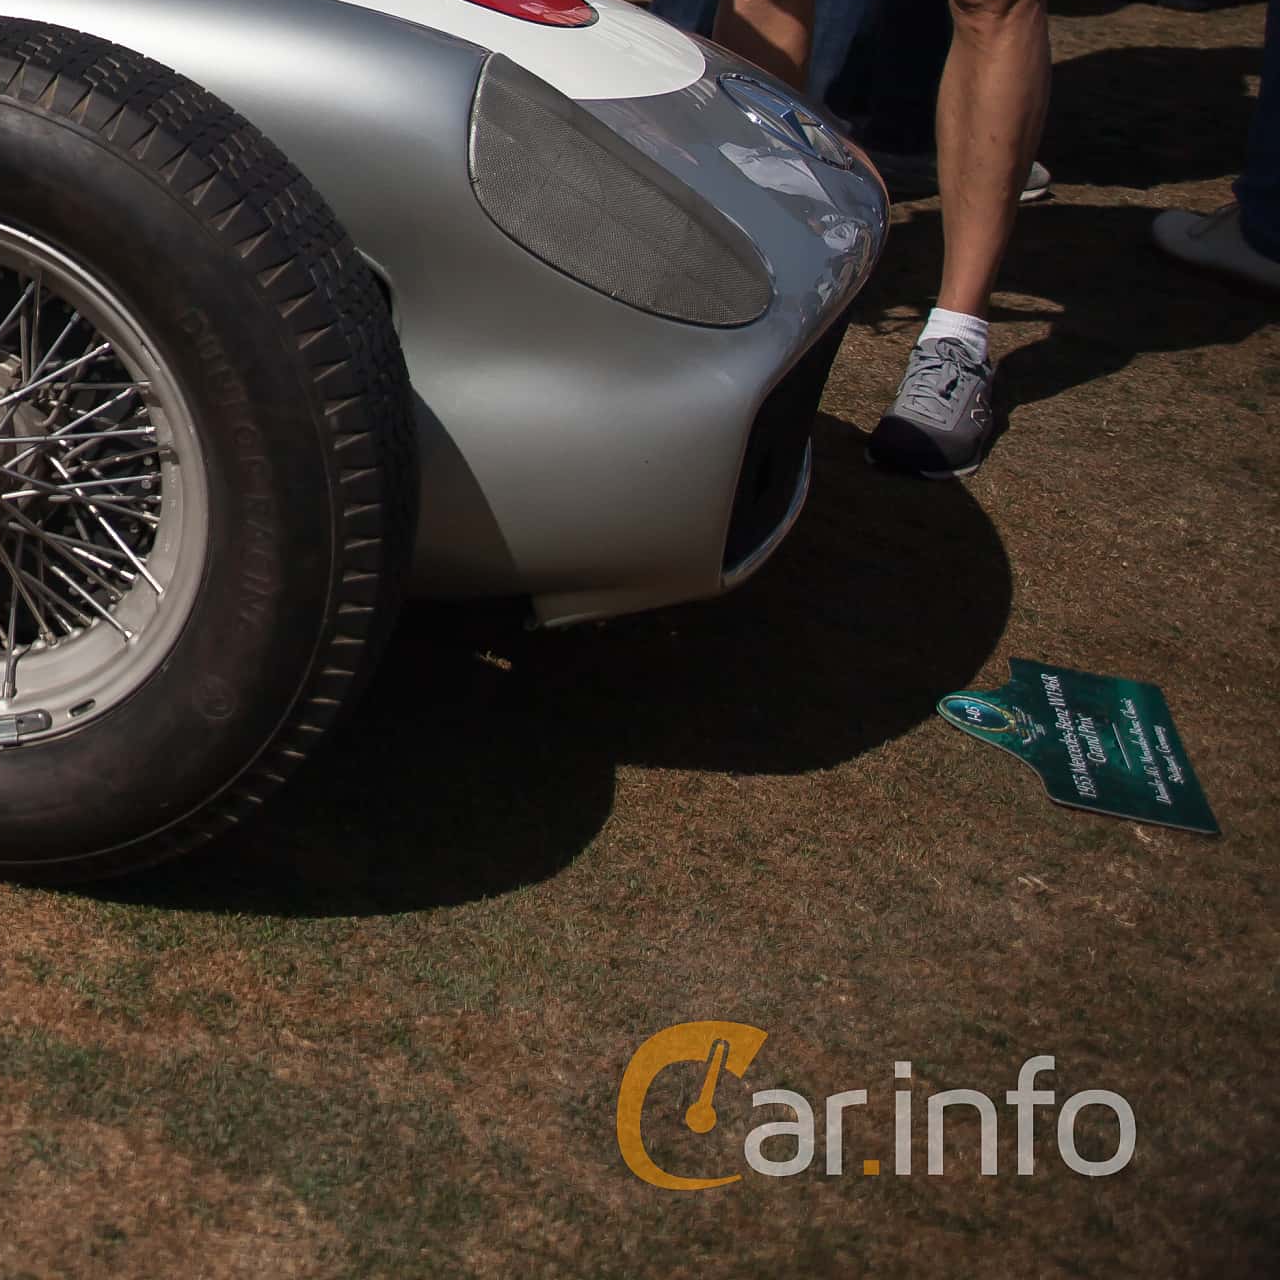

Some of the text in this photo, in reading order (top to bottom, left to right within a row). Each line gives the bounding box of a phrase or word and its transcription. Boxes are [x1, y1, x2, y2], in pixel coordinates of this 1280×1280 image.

[1041, 673, 1097, 798] 1955 Mercedes-Benz W196R
[1079, 733, 1107, 764] Grand
